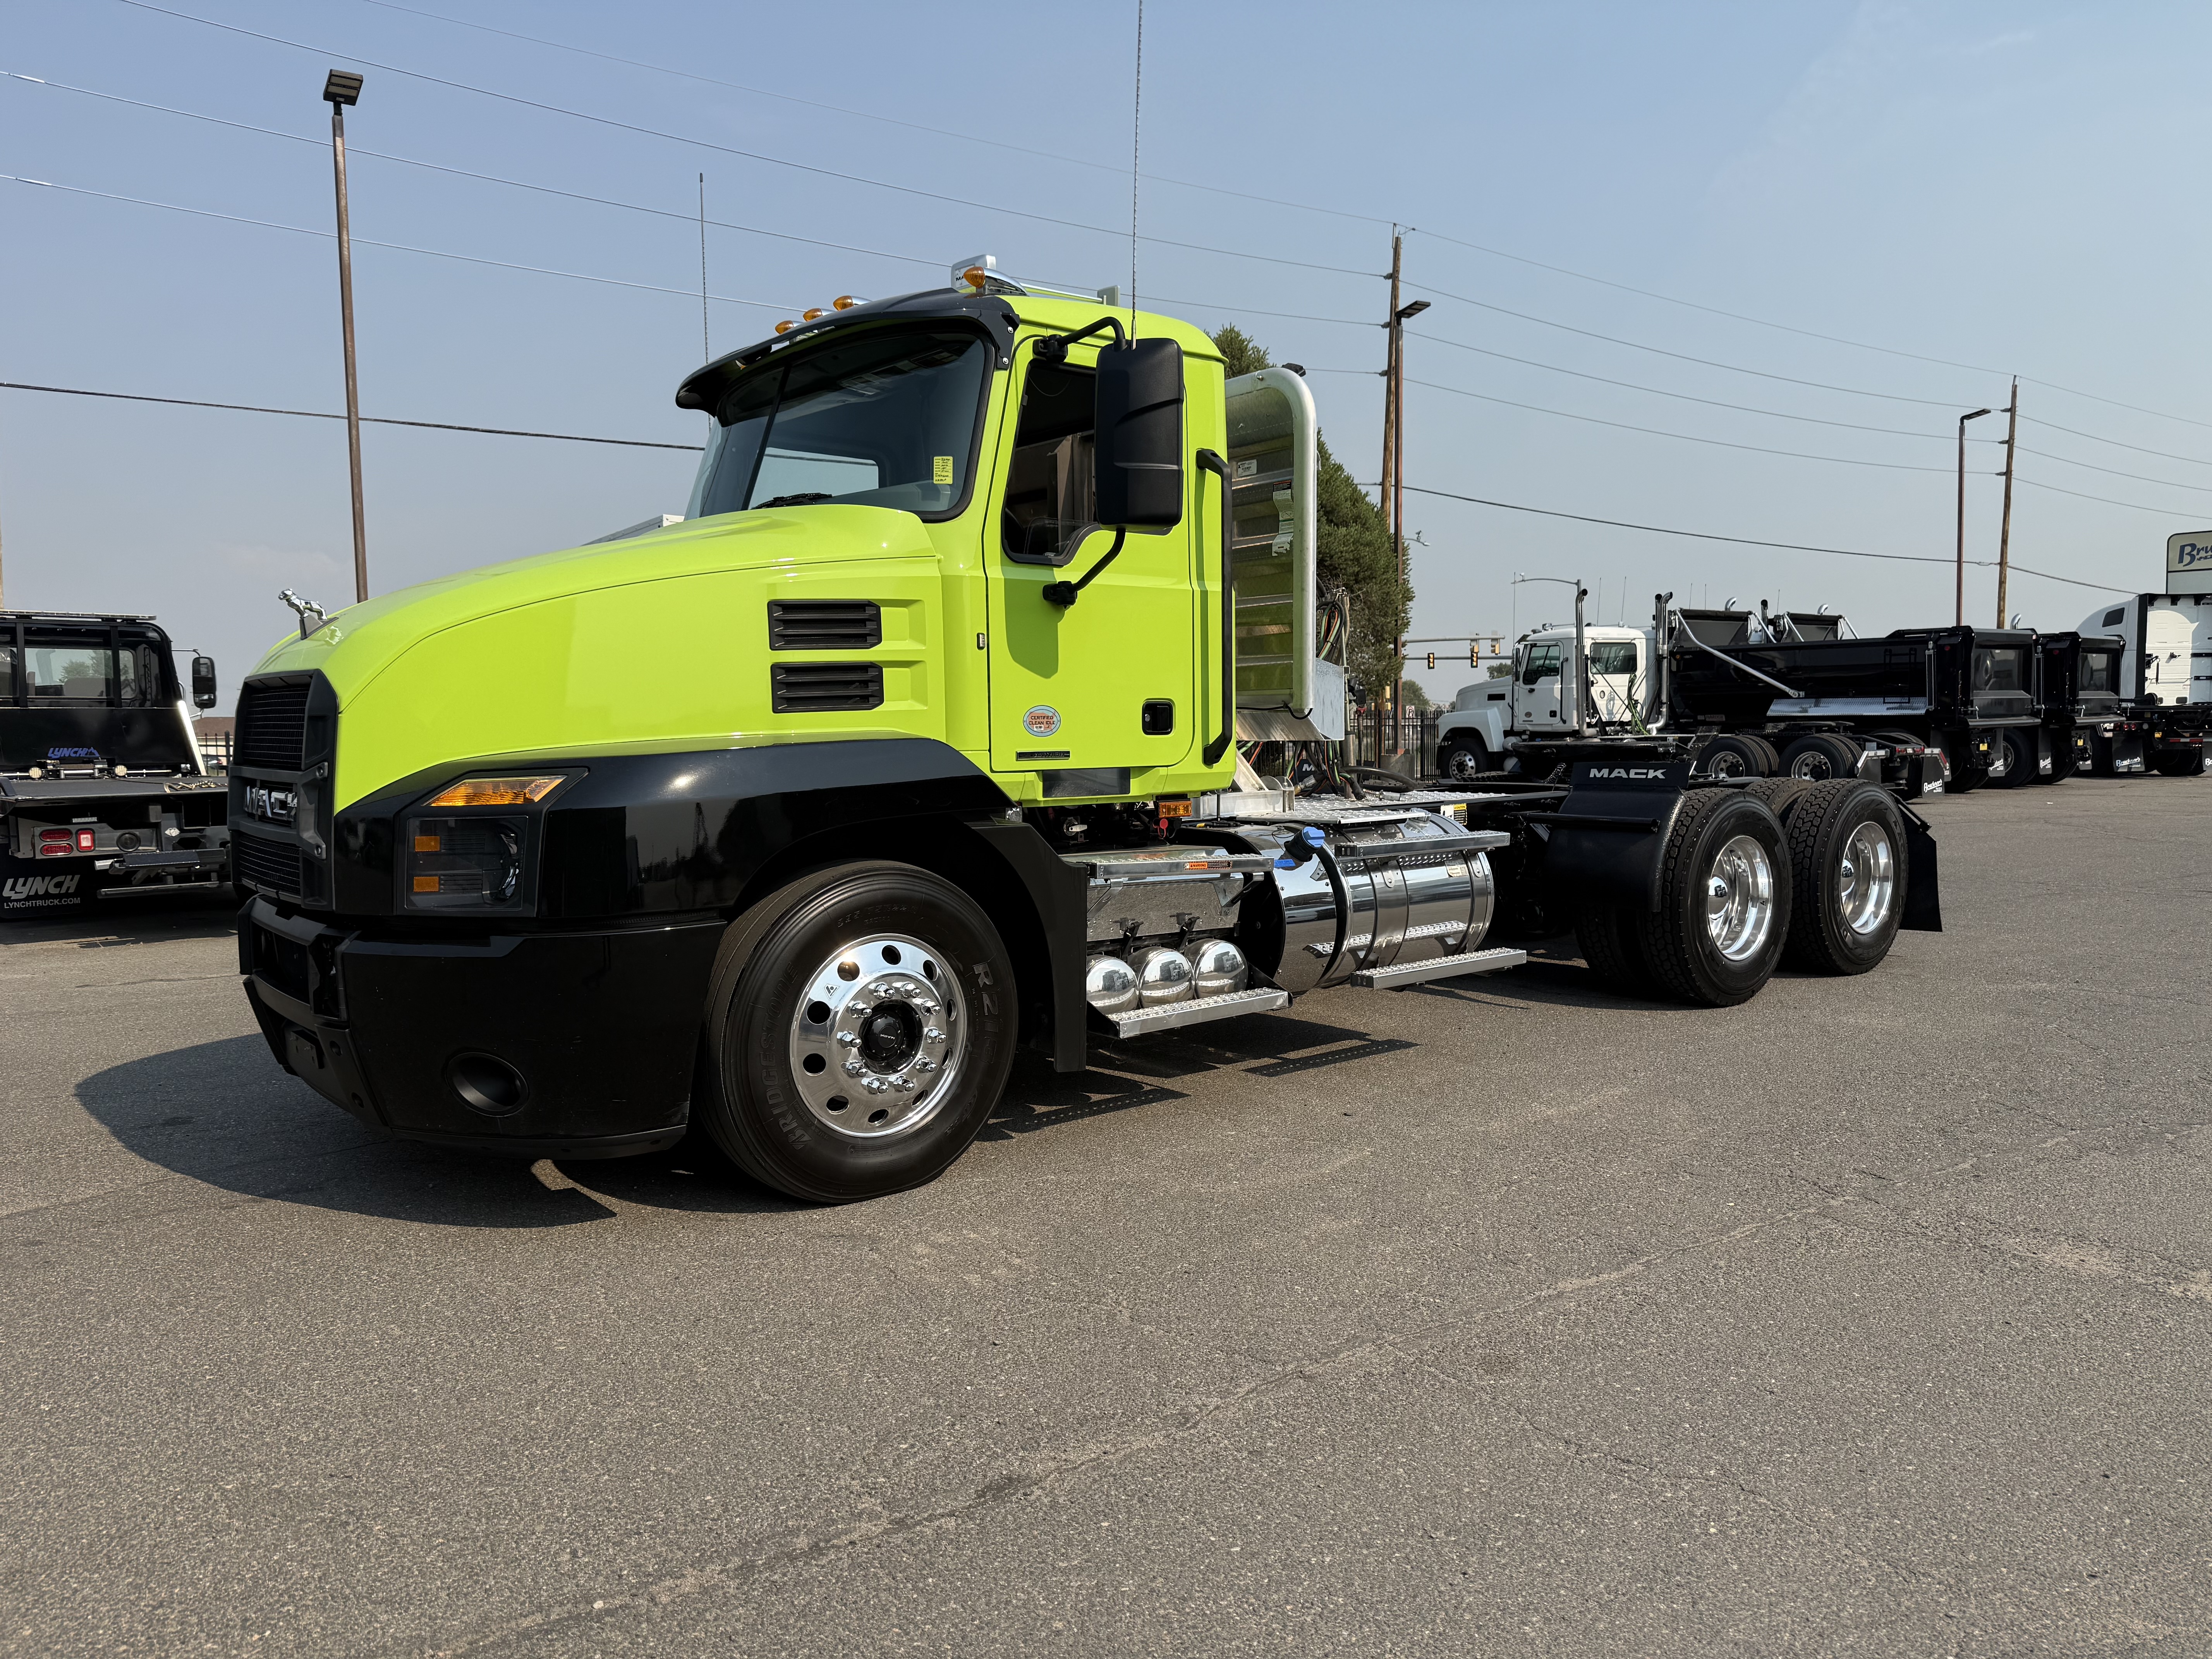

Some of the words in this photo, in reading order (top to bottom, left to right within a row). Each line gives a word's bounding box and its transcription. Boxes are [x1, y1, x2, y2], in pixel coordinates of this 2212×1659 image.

[48, 747, 88, 759] LYNCH
[1589, 768, 1666, 779] MACK
[244, 785, 297, 821] MACK
[2, 875, 81, 900] LYNCH
[4, 897, 81, 908] LYNCHTRUCK.COM
[759, 961, 813, 1151] BRIDGESTONE
